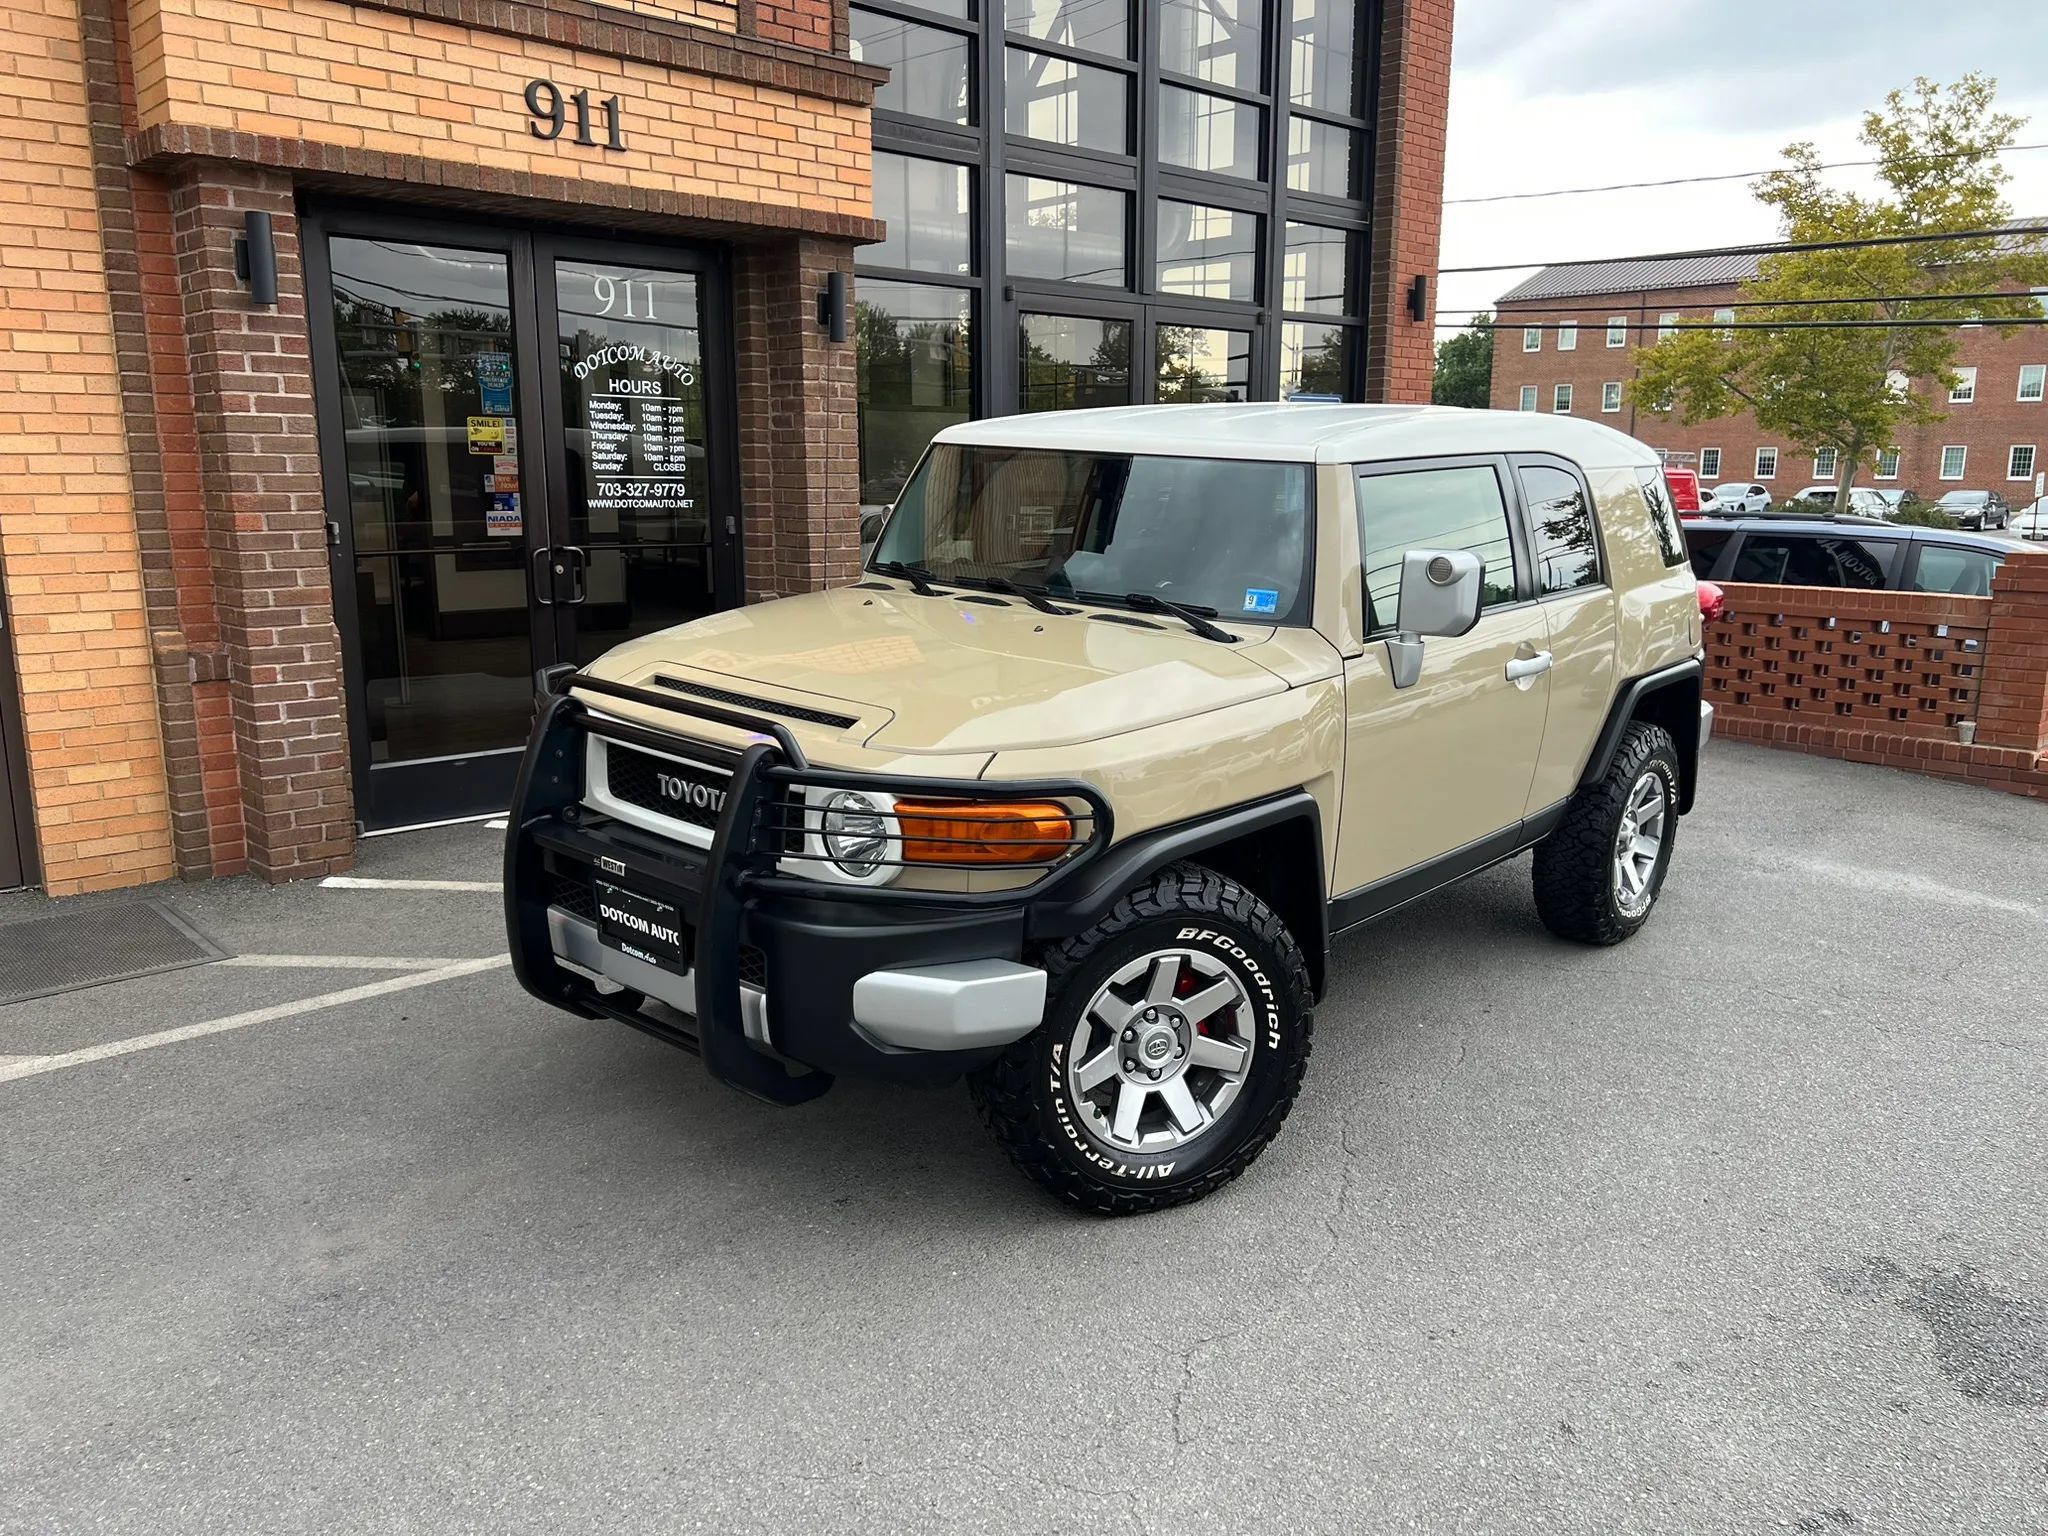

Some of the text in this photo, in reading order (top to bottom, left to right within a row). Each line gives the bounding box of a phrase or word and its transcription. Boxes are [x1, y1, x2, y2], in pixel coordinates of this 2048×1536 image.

[524, 79, 628, 152] 911
[593, 276, 658, 319] 911
[574, 345, 694, 386] DOTCOM AUTO
[608, 378, 662, 395] HOURS
[589, 400, 622, 411] Monday:
[641, 403, 662, 413] 10am
[589, 410, 624, 421] Tuesday:
[642, 413, 662, 422] 10am
[470, 419, 500, 428] SMILE!
[590, 421, 636, 432] Wednesday:
[642, 423, 663, 432] 10am
[591, 431, 628, 442] Thursday:
[643, 433, 663, 442] 10am
[591, 441, 617, 452] Friday:
[643, 443, 663, 452] 10am
[592, 451, 628, 463] Saturday:
[643, 453, 664, 462] 10am
[592, 462, 686, 472] Sunday: CLOSED
[596, 482, 685, 497] 703-327-9779
[587, 499, 694, 508] WWW.DOTCOMAUTO.NET
[488, 515, 520, 523] NIADA
[600, 904, 649, 934] DOTCOM
[622, 942, 657, 964] Dotcom Auto
[1175, 927, 1281, 1050] BFGoodrich
[1050, 1043, 1064, 1092] T/A
[1055, 1098, 1176, 1179] All-Terrain
